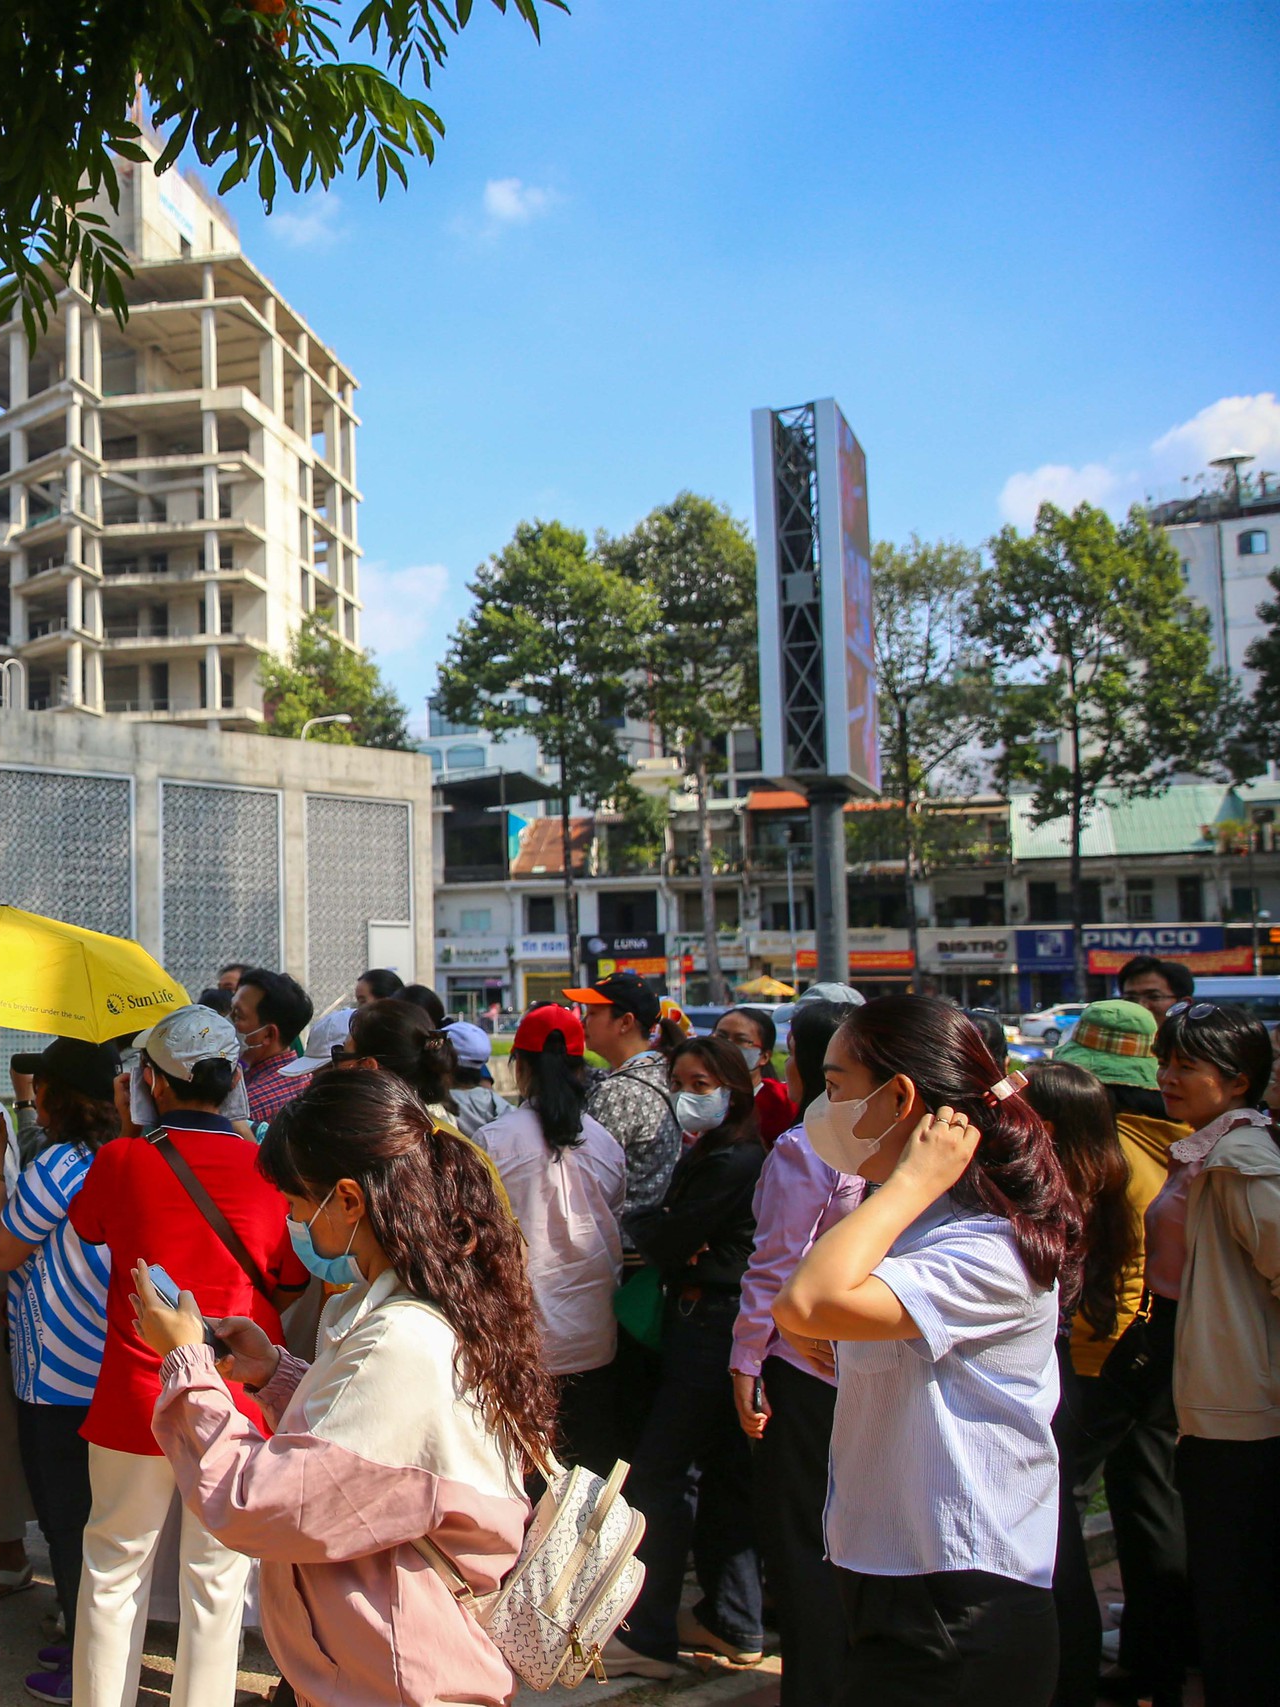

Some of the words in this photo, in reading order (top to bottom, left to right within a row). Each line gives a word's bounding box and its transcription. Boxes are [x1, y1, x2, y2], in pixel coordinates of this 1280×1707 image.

[613, 938, 648, 950] LUNA
[937, 940, 1008, 952] BISTRO
[1082, 929, 1200, 948] PINACO
[127, 994, 153, 1009] Sun
[152, 989, 175, 1004] Life
[13, 1002, 39, 1013] brighter
[40, 1008, 60, 1017] under
[61, 1010, 73, 1019] the
[74, 1013, 86, 1021] sun
[27, 1286, 41, 1324] TOMMY
[22, 1311, 33, 1354] TOMMY
